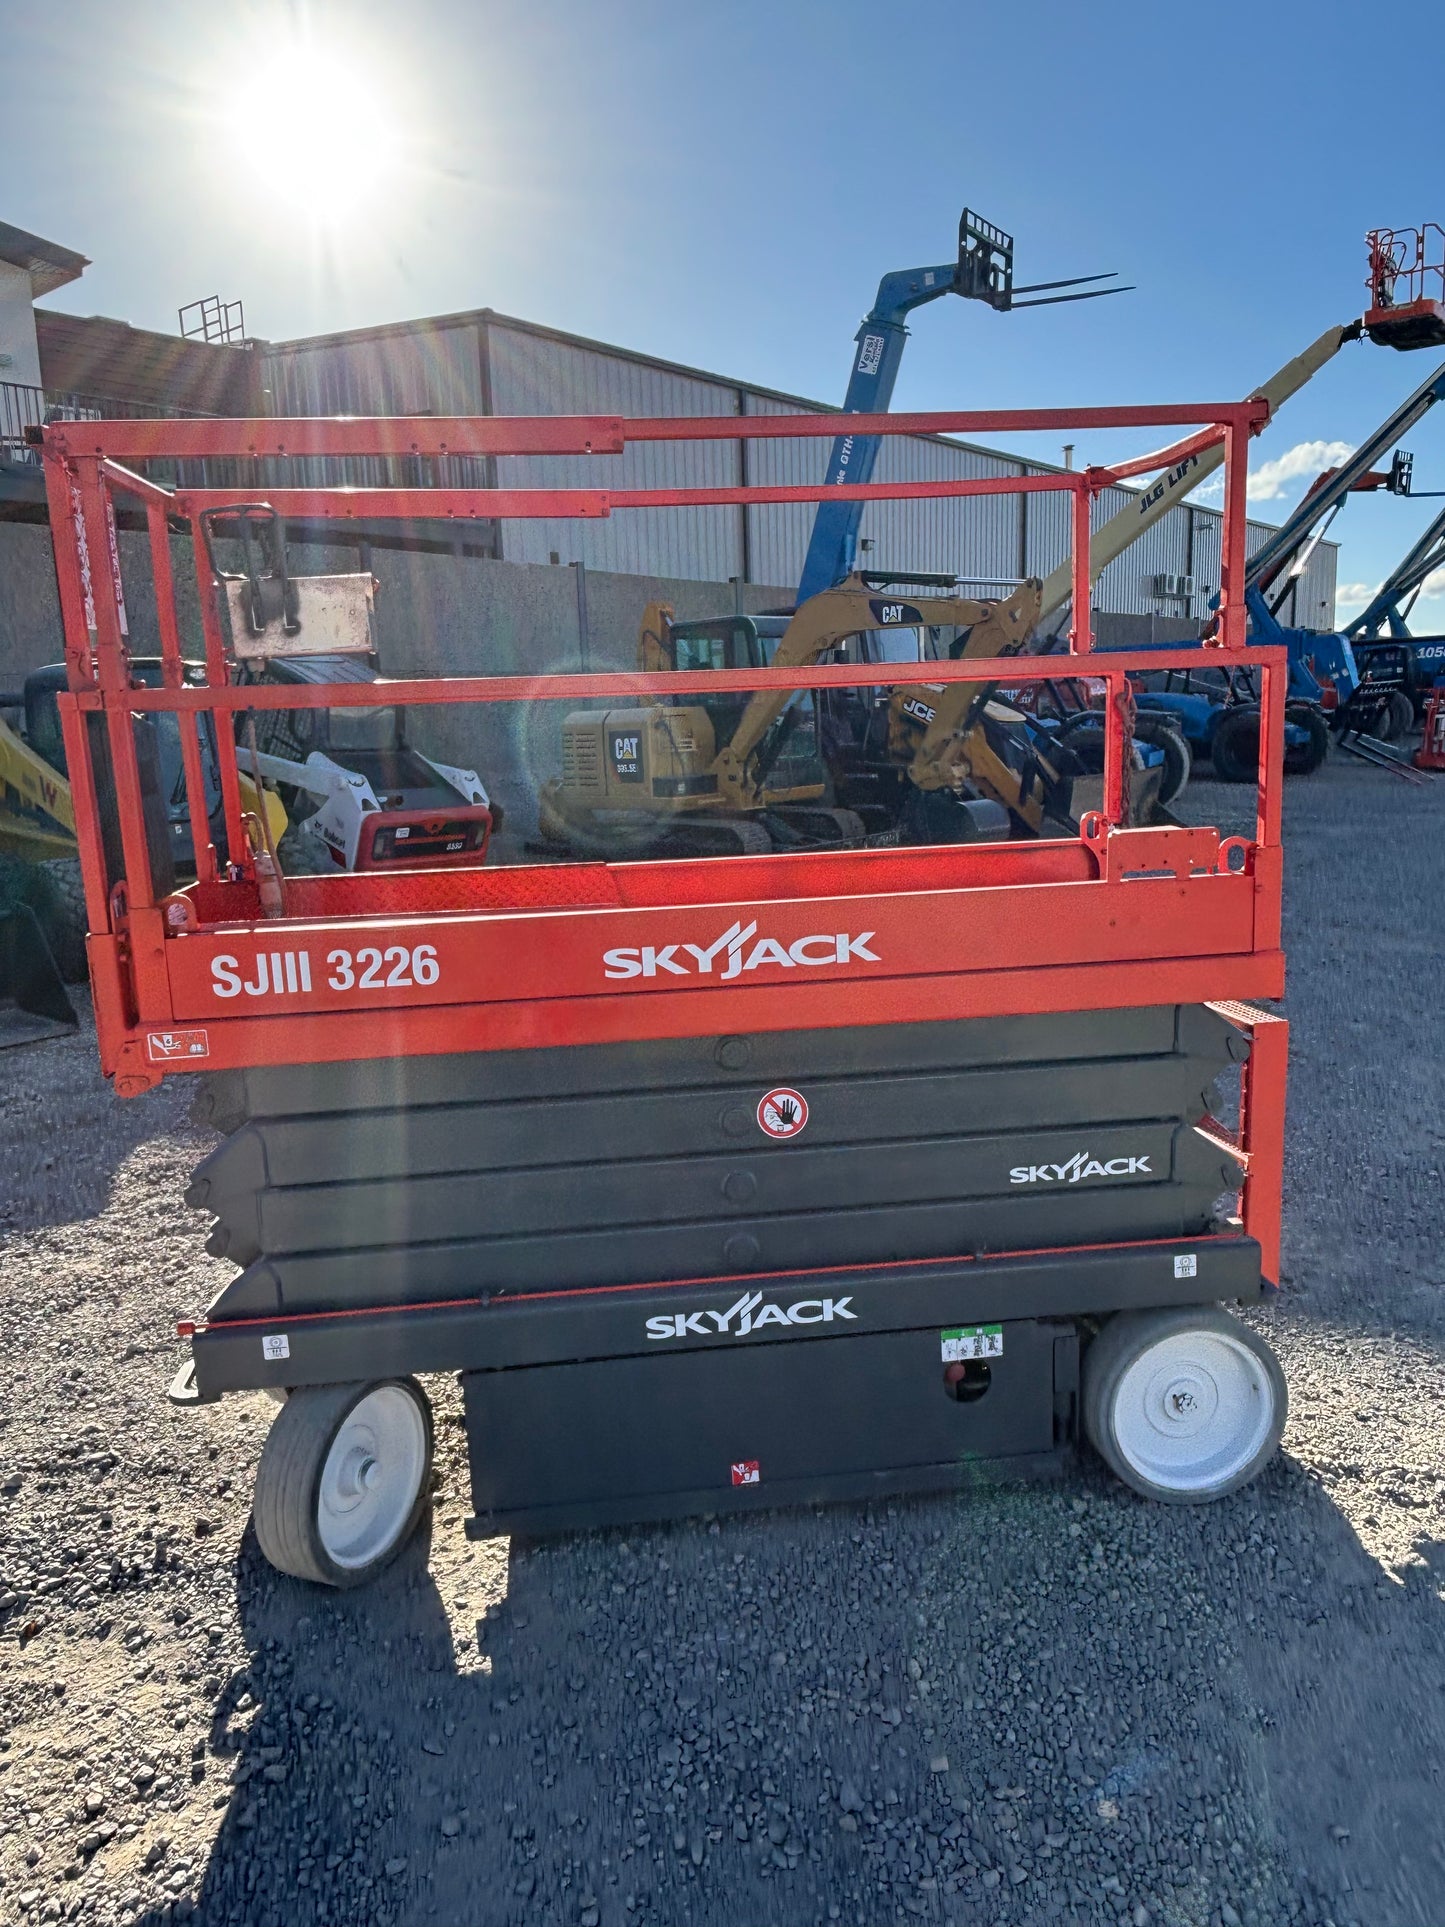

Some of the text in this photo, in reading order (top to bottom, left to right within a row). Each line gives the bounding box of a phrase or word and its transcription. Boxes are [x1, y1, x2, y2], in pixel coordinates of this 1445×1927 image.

[840, 435, 854, 465] GTH-
[1140, 455, 1198, 514] JLG LIFT
[882, 604, 904, 623] CAT
[903, 699, 937, 722] JCB
[615, 737, 638, 760] CAT
[602, 919, 882, 980] SKYJACK
[210, 944, 440, 998] SJIII 3226
[1009, 1151, 1152, 1184] SKYJACK
[645, 1290, 858, 1339] SKYJACK
